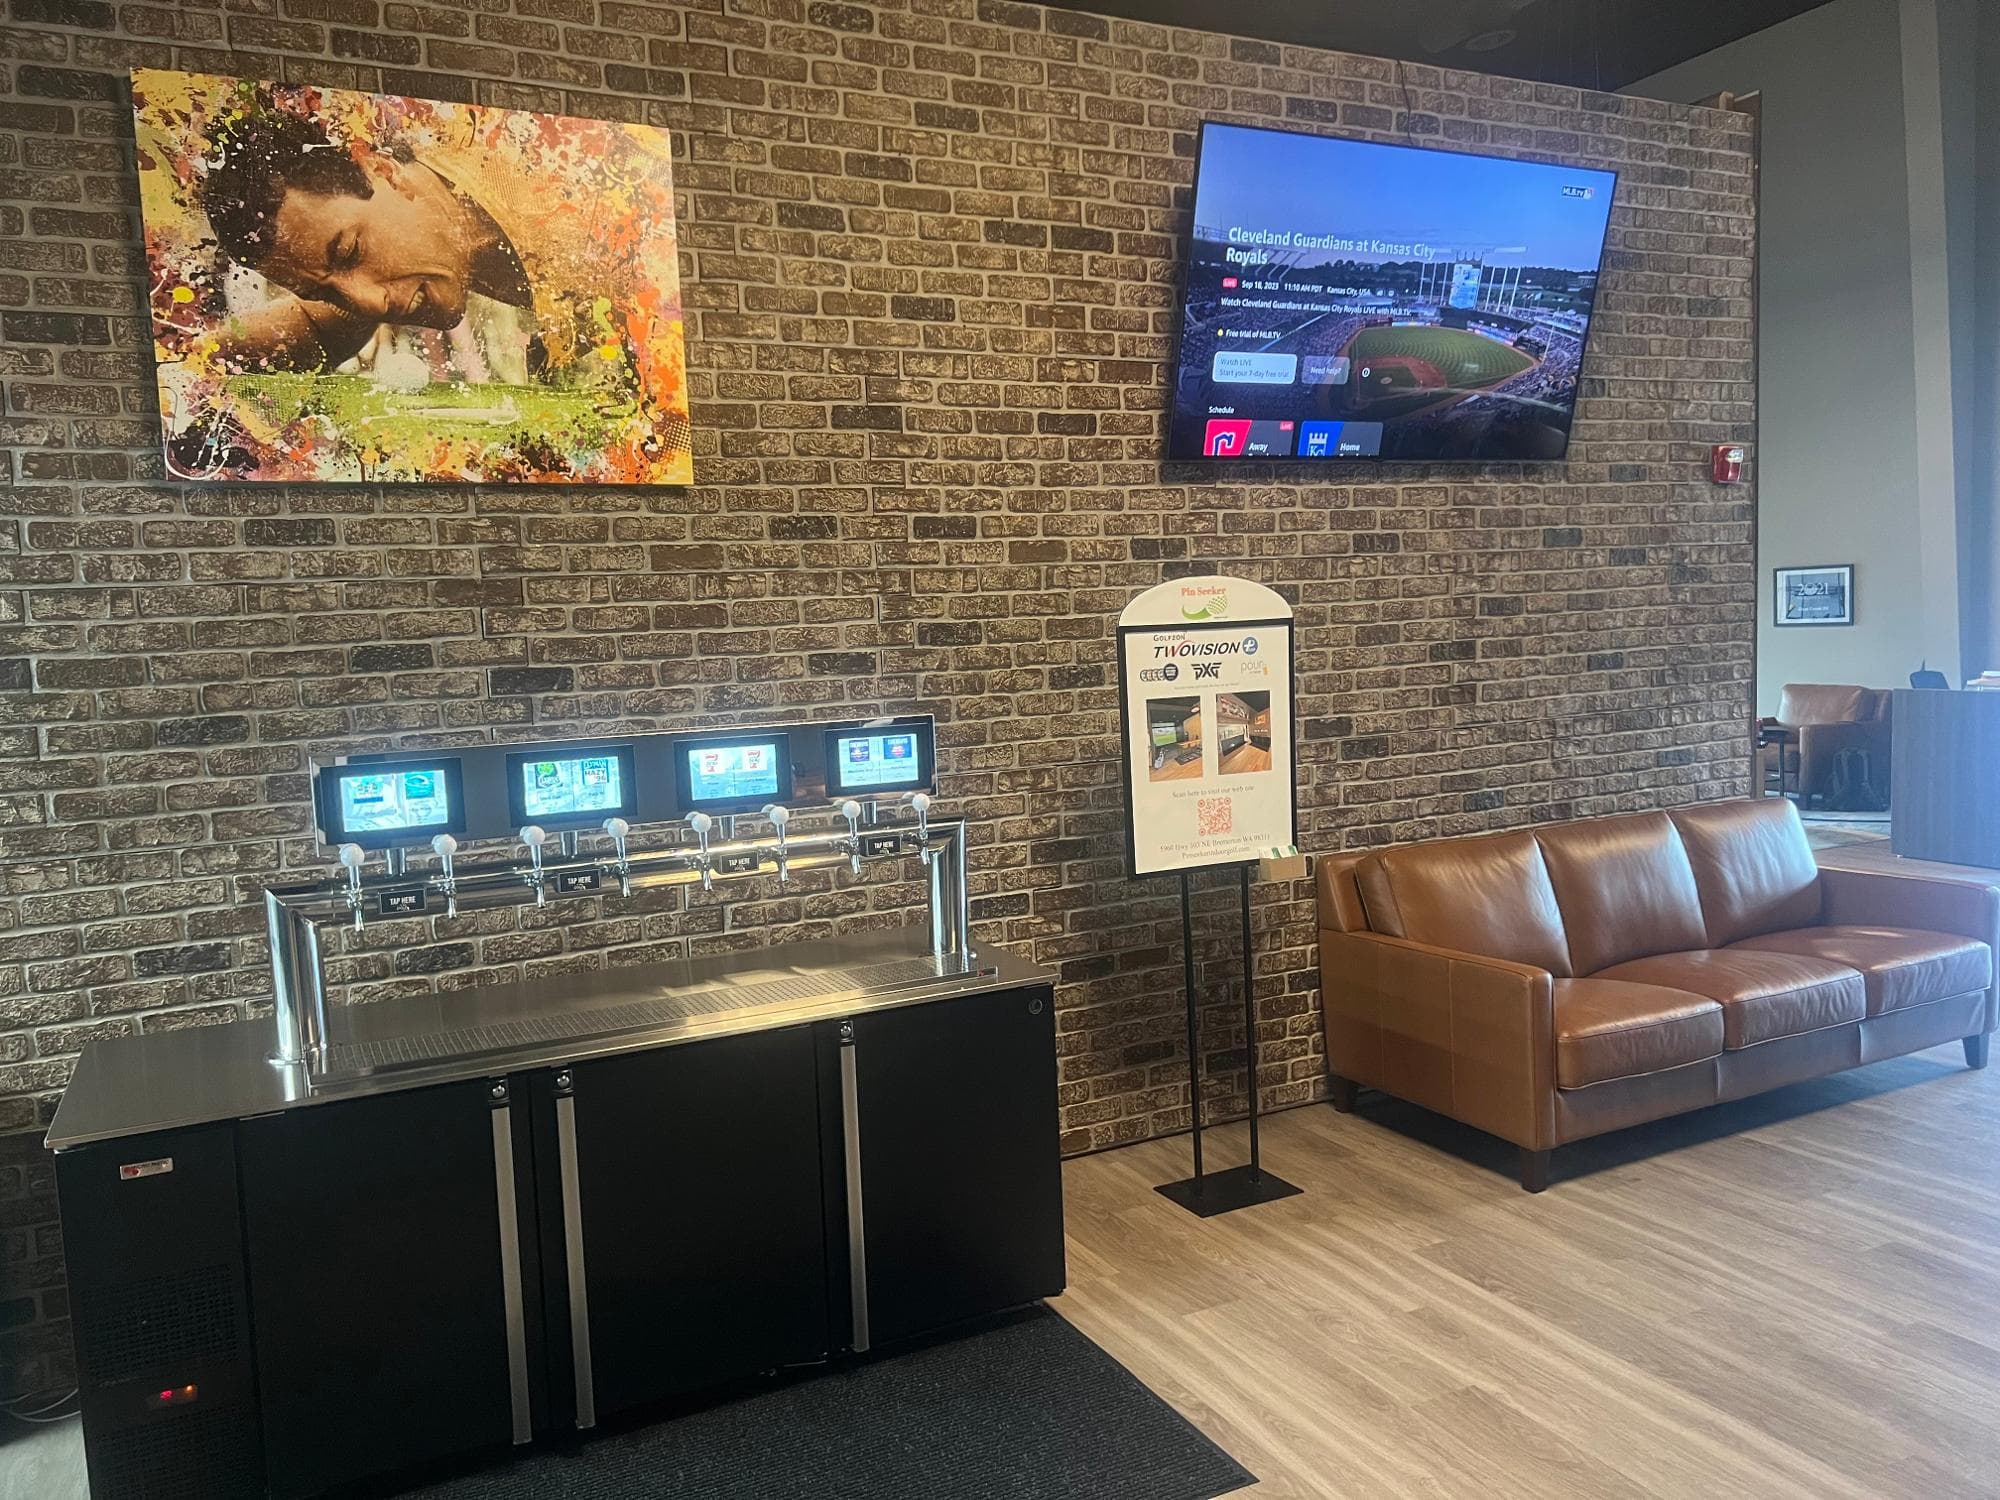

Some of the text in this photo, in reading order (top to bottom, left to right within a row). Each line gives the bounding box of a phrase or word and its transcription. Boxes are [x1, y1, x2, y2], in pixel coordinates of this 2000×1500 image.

[1229, 227, 1436, 260] Cleveland Guardians at Kansas City
[1226, 247, 1268, 266] Royals
[1241, 281, 1253, 290] Sep
[1264, 282, 1279, 291] 2023
[1284, 283, 1300, 292] 11:10
[1300, 284, 1311, 292] AM
[1311, 284, 1323, 293] PDT
[1327, 286, 1346, 295] Kansas
[1346, 287, 1358, 298] City,
[1358, 288, 1371, 297] USA
[1221, 297, 1241, 307] Watch
[1241, 298, 1272, 308] Cleveland
[1272, 300, 1302, 310] Guardians
[1303, 303, 1310, 311] at
[1310, 303, 1331, 312] Kansas
[1331, 304, 1343, 314] City
[1343, 304, 1362, 315] Royals
[1363, 306, 1377, 314] LIVE
[1377, 307, 1389, 315] with
[1225, 329, 1239, 338] Free
[1239, 329, 1252, 338] trial
[1252, 329, 1259, 338] of
[1220, 358, 1252, 367] Watch LIVE
[1219, 368, 1290, 378] Start your 7-day free trial
[1310, 366, 1342, 376] Need help?
[1208, 406, 1235, 415] Schedule
[1248, 442, 1269, 453] Away
[1340, 443, 1361, 452] Home
[1181, 585, 1227, 597] Pin Seeker
[584, 769, 606, 777] HAZY
[1172, 791, 1186, 799] Scan
[1207, 787, 1220, 796] visit
[1231, 785, 1244, 793] web
[883, 840, 894, 848] HERE
[1201, 840, 1211, 848] NE
[728, 857, 750, 867] TAP HERE
[567, 875, 592, 885] TAP HERE
[389, 895, 416, 906] TAP HERE
